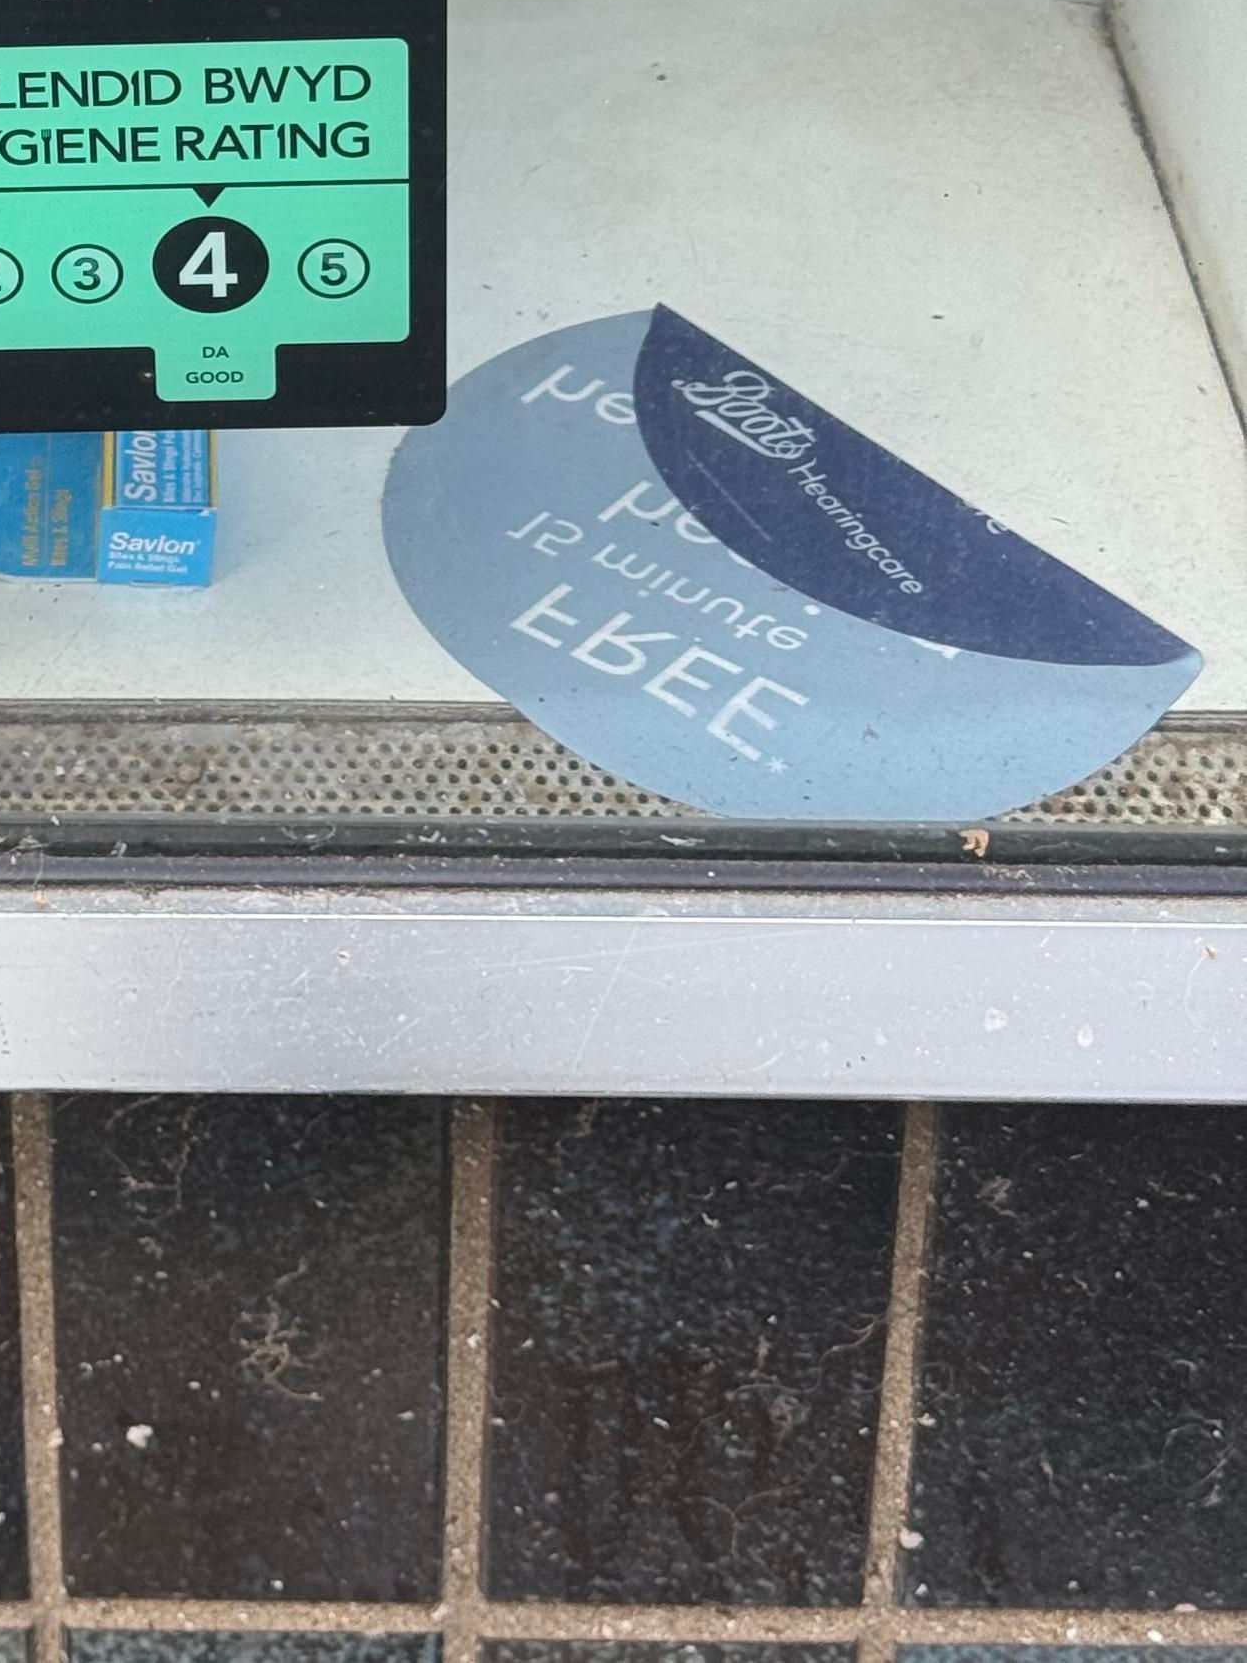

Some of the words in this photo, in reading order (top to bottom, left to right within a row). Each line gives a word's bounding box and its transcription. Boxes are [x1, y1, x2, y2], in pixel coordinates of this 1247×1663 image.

[204, 65, 370, 104] BWYD
[176, 121, 370, 161] RATING
[73, 258, 102, 290] 3
[179, 231, 237, 297] 4
[321, 252, 347, 285] 5
[202, 346, 229, 358] DA
[186, 371, 244, 384] GOOD
[671, 370, 815, 461] Boots
[789, 460, 924, 596] Hearingcare
[109, 532, 195, 555] Savlon
